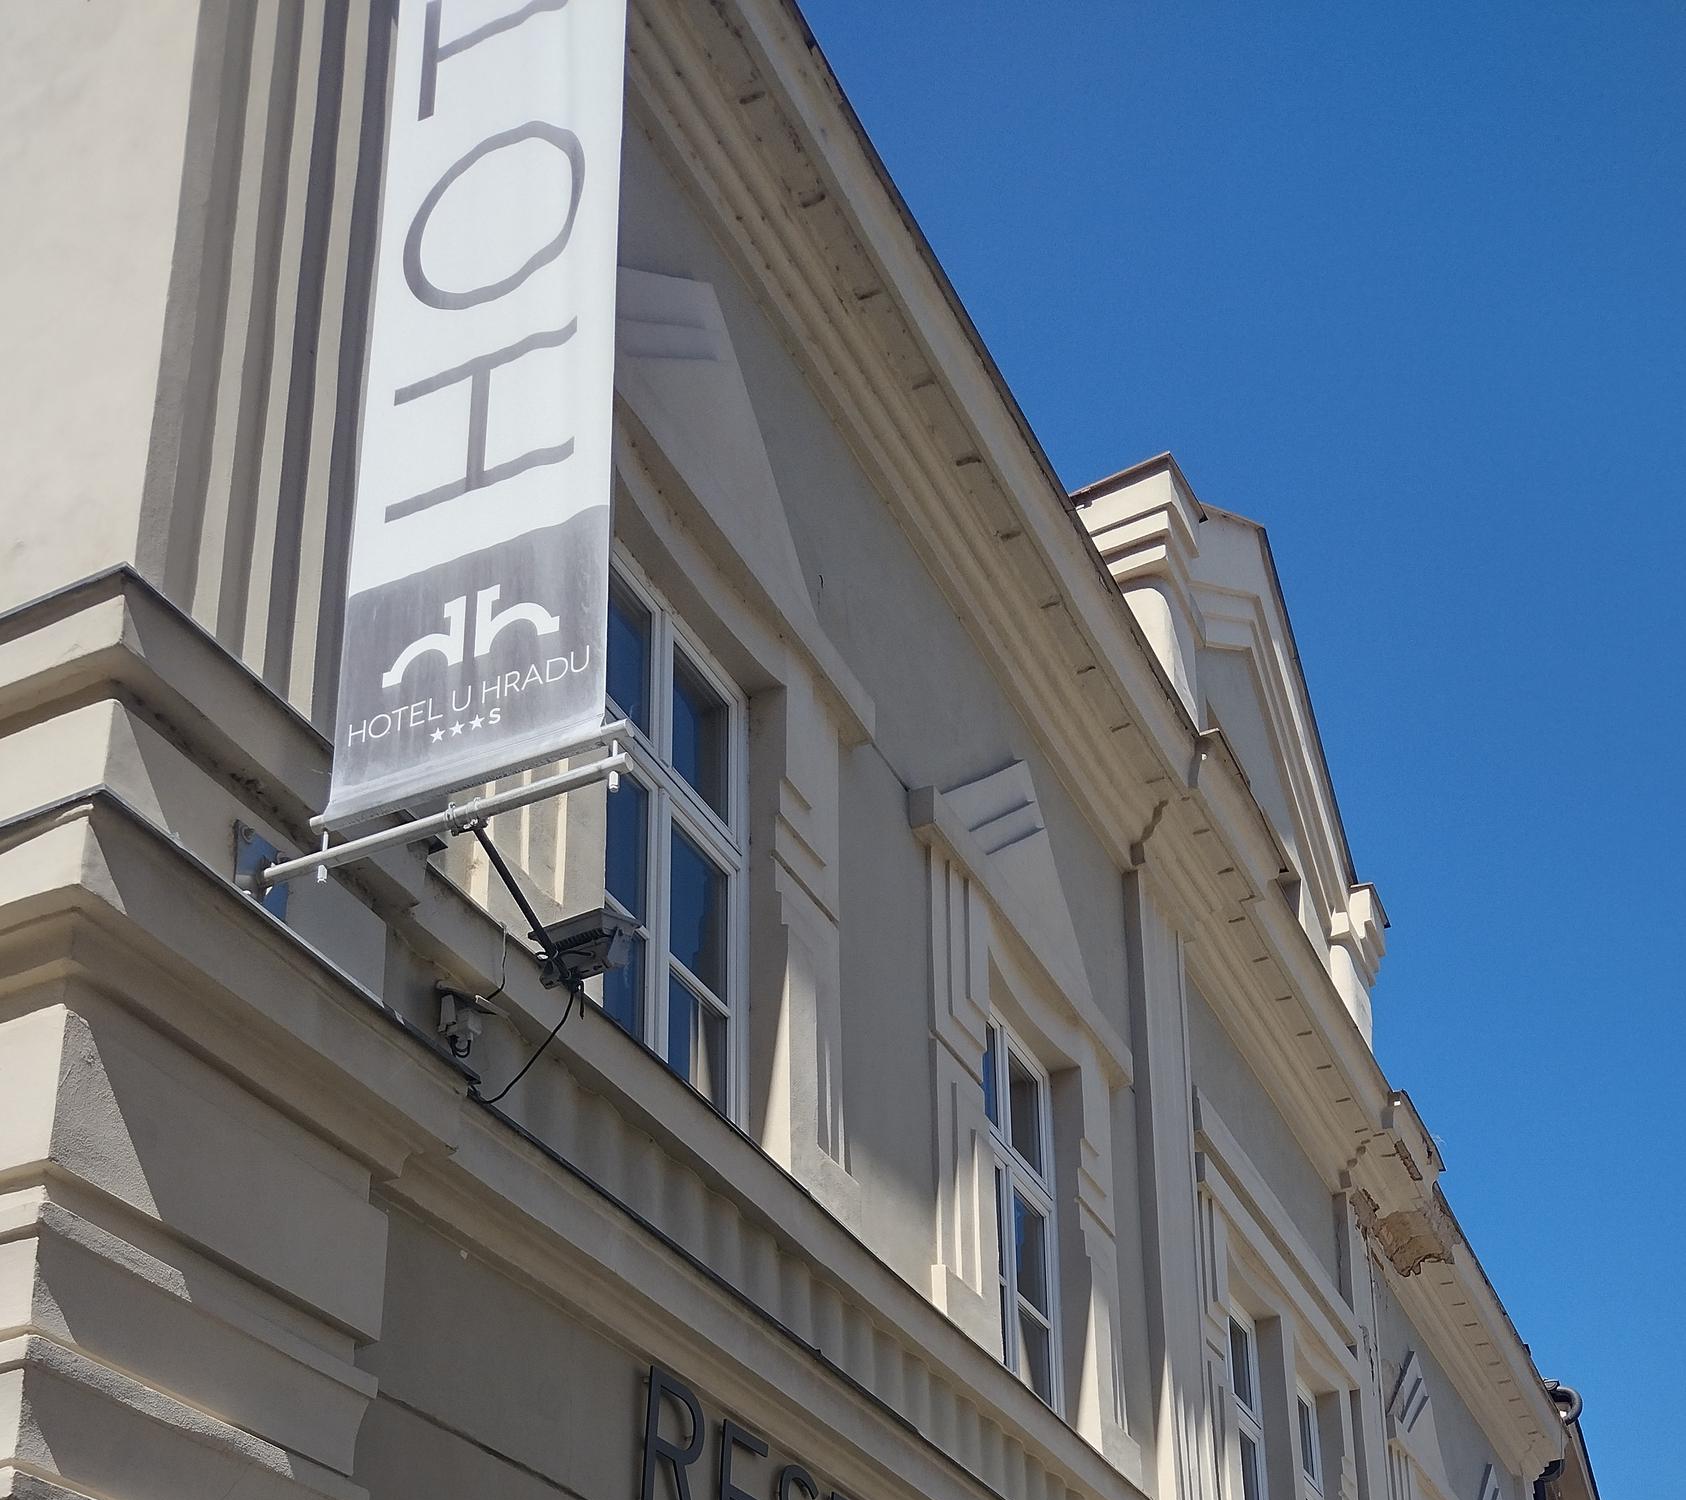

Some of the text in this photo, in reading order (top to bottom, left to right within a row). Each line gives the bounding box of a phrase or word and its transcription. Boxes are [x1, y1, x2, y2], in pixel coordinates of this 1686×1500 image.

[347, 644, 591, 748] HOTEL U HRADU
